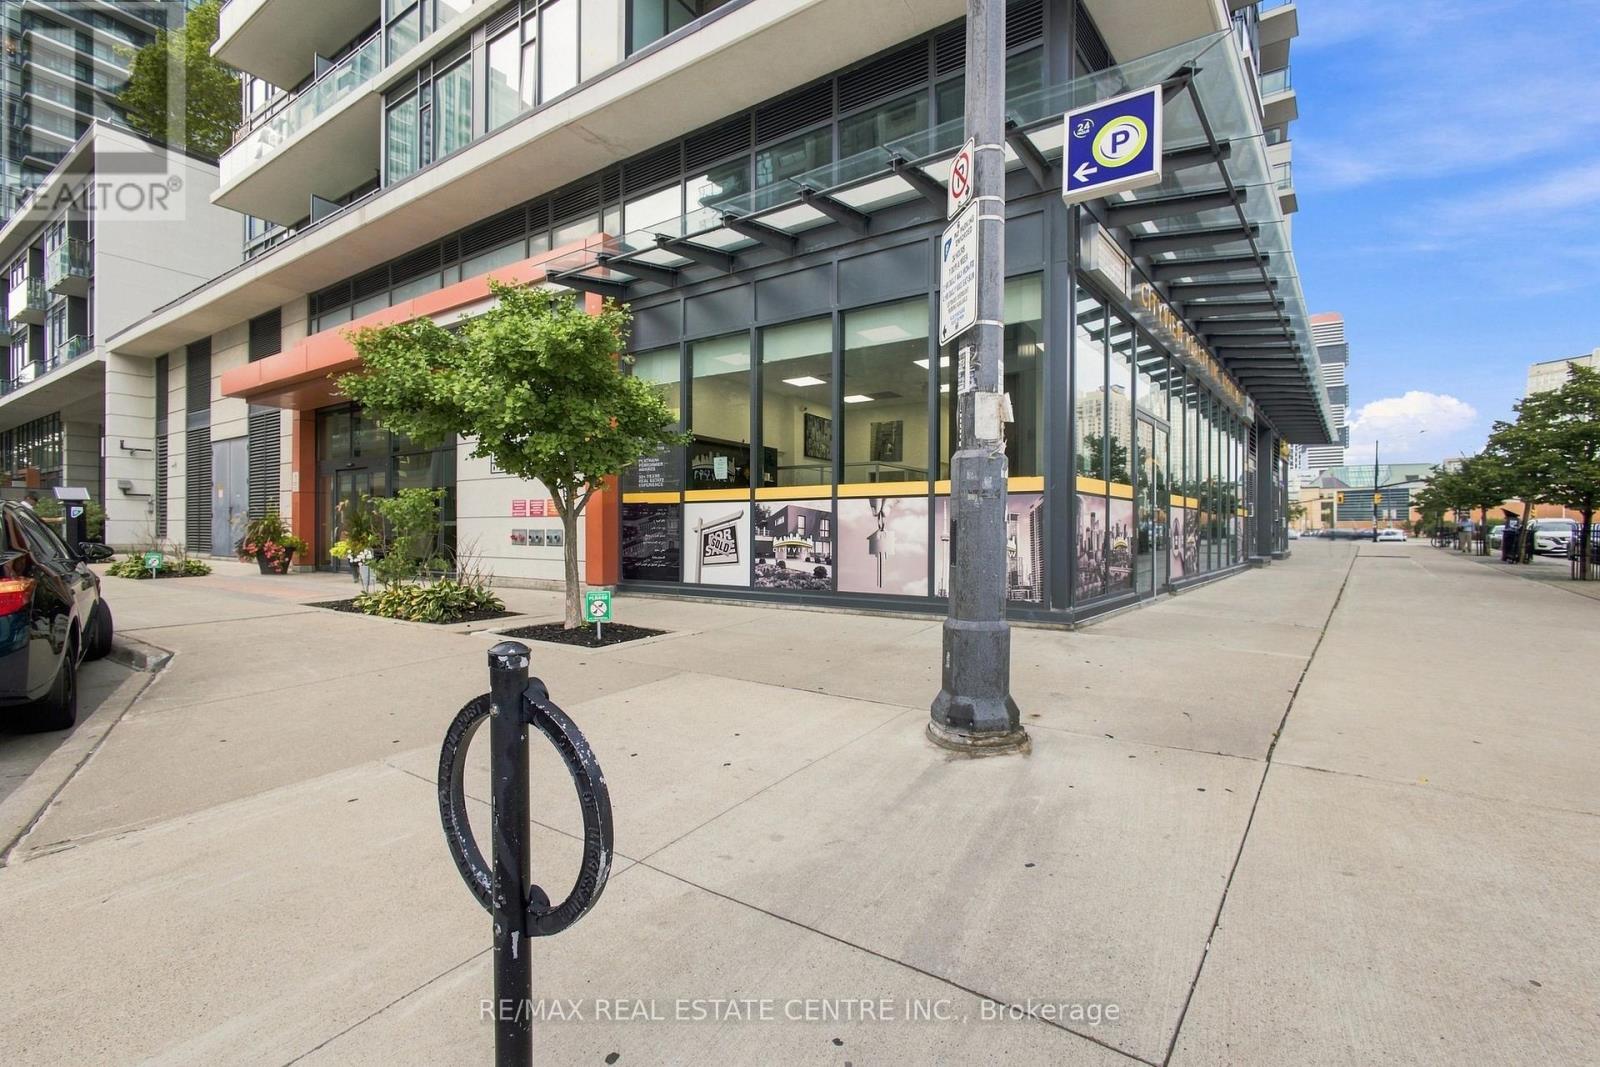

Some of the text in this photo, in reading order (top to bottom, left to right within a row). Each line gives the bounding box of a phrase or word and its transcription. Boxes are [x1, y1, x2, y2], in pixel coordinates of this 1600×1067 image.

[1077, 121, 1091, 132] 24
[1111, 130, 1130, 154] P
[705, 540, 736, 556] SAE
[711, 537, 730, 553] SOLD
